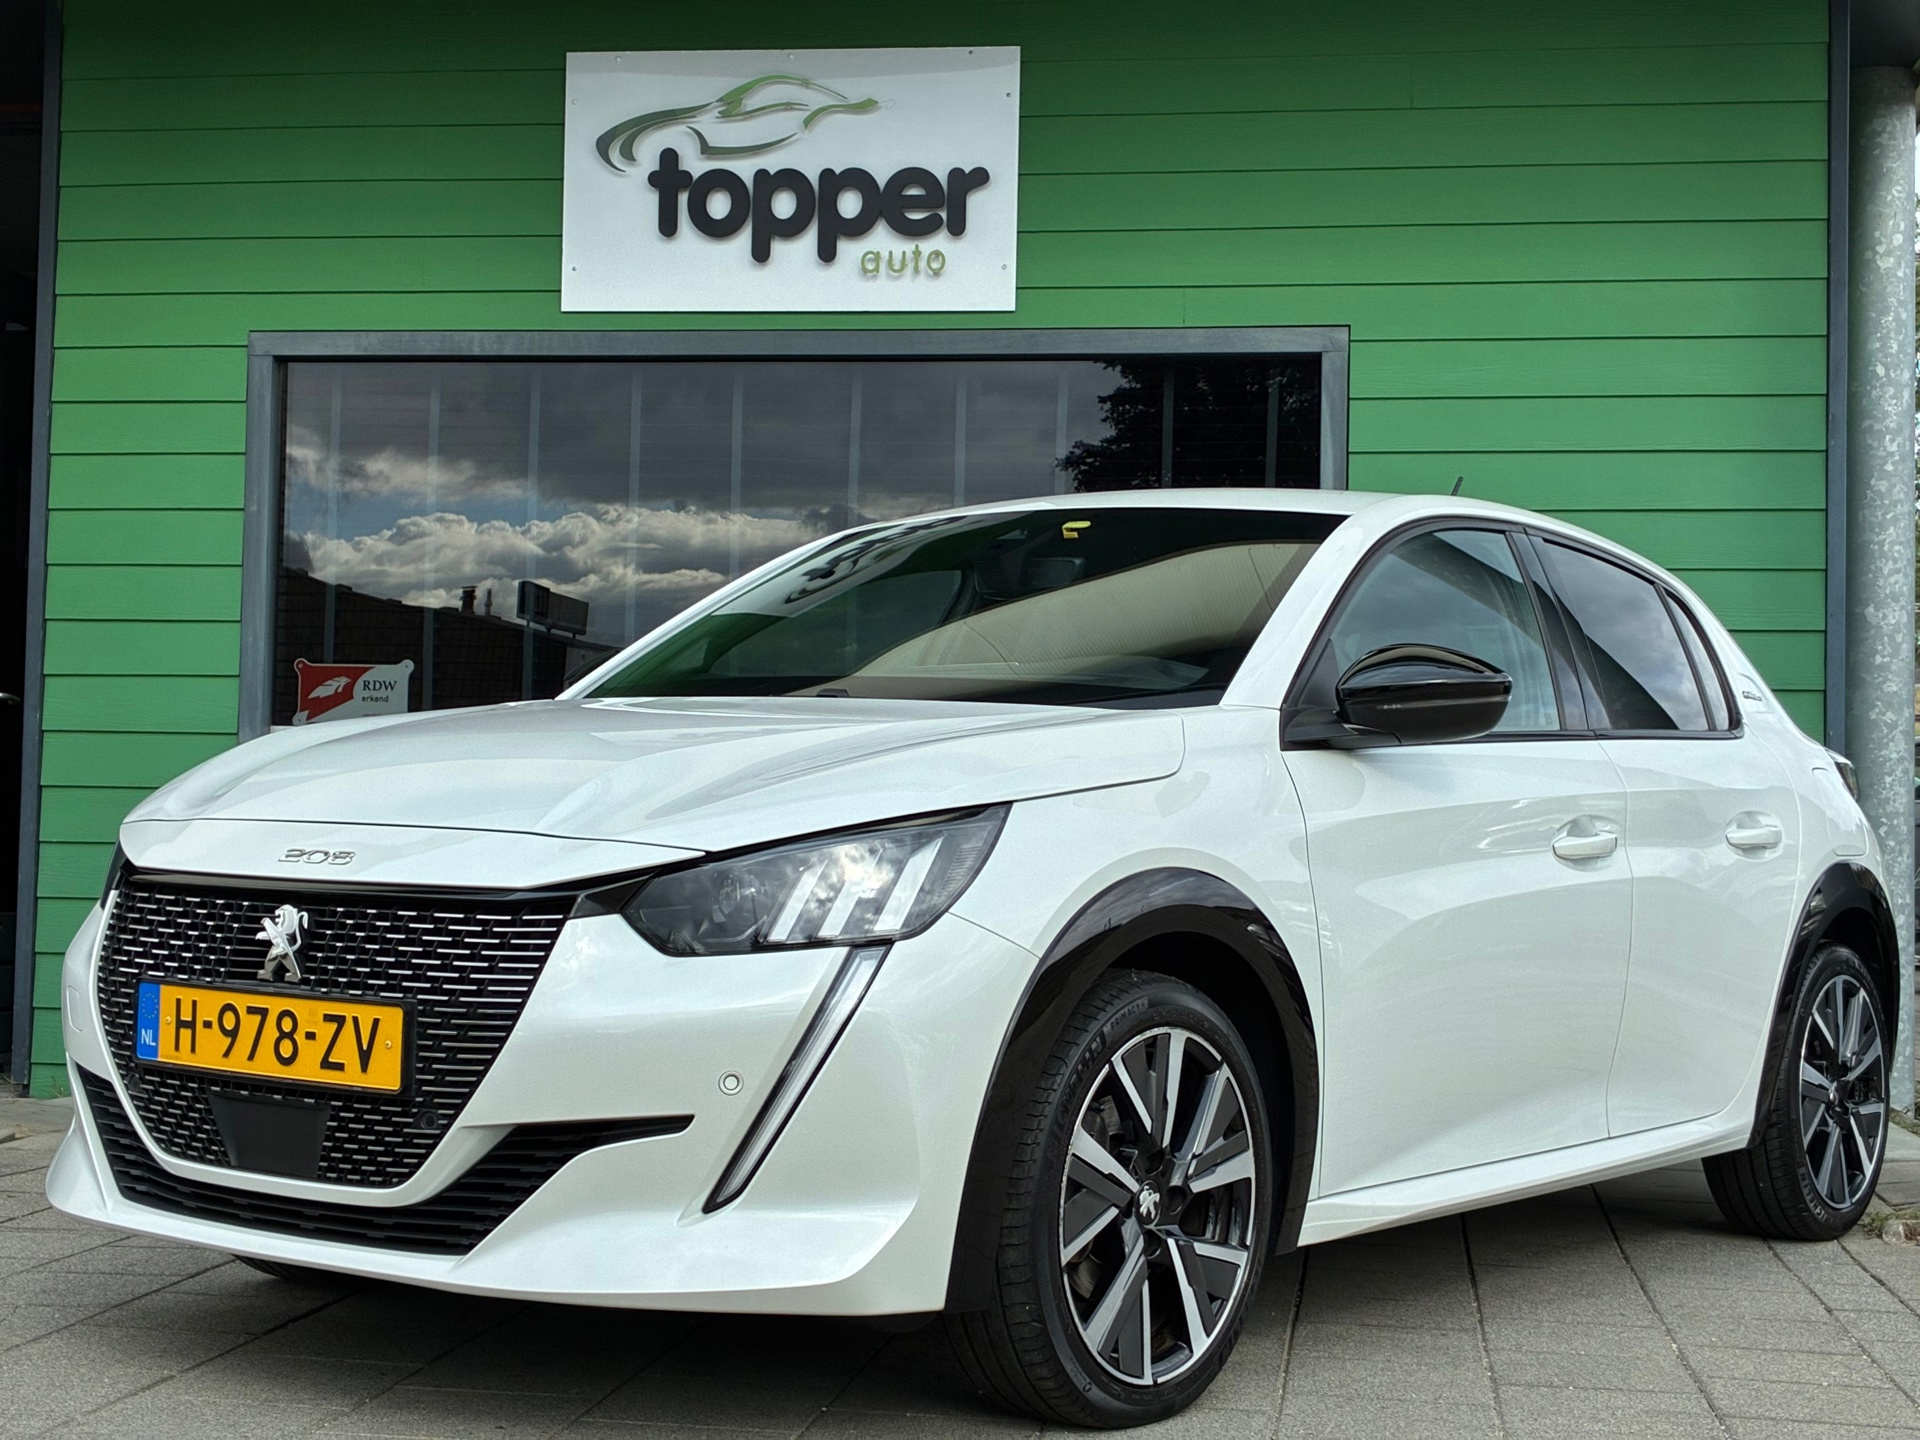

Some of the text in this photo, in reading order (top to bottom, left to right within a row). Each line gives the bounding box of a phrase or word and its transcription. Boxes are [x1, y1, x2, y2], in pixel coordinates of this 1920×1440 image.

[647, 147, 990, 263] topper
[860, 244, 946, 275] auto
[362, 680, 398, 692] RDW
[361, 694, 389, 703] erkend
[278, 848, 356, 866] 208
[140, 1027, 156, 1046] NL
[173, 997, 381, 1074] H-978-ZV
